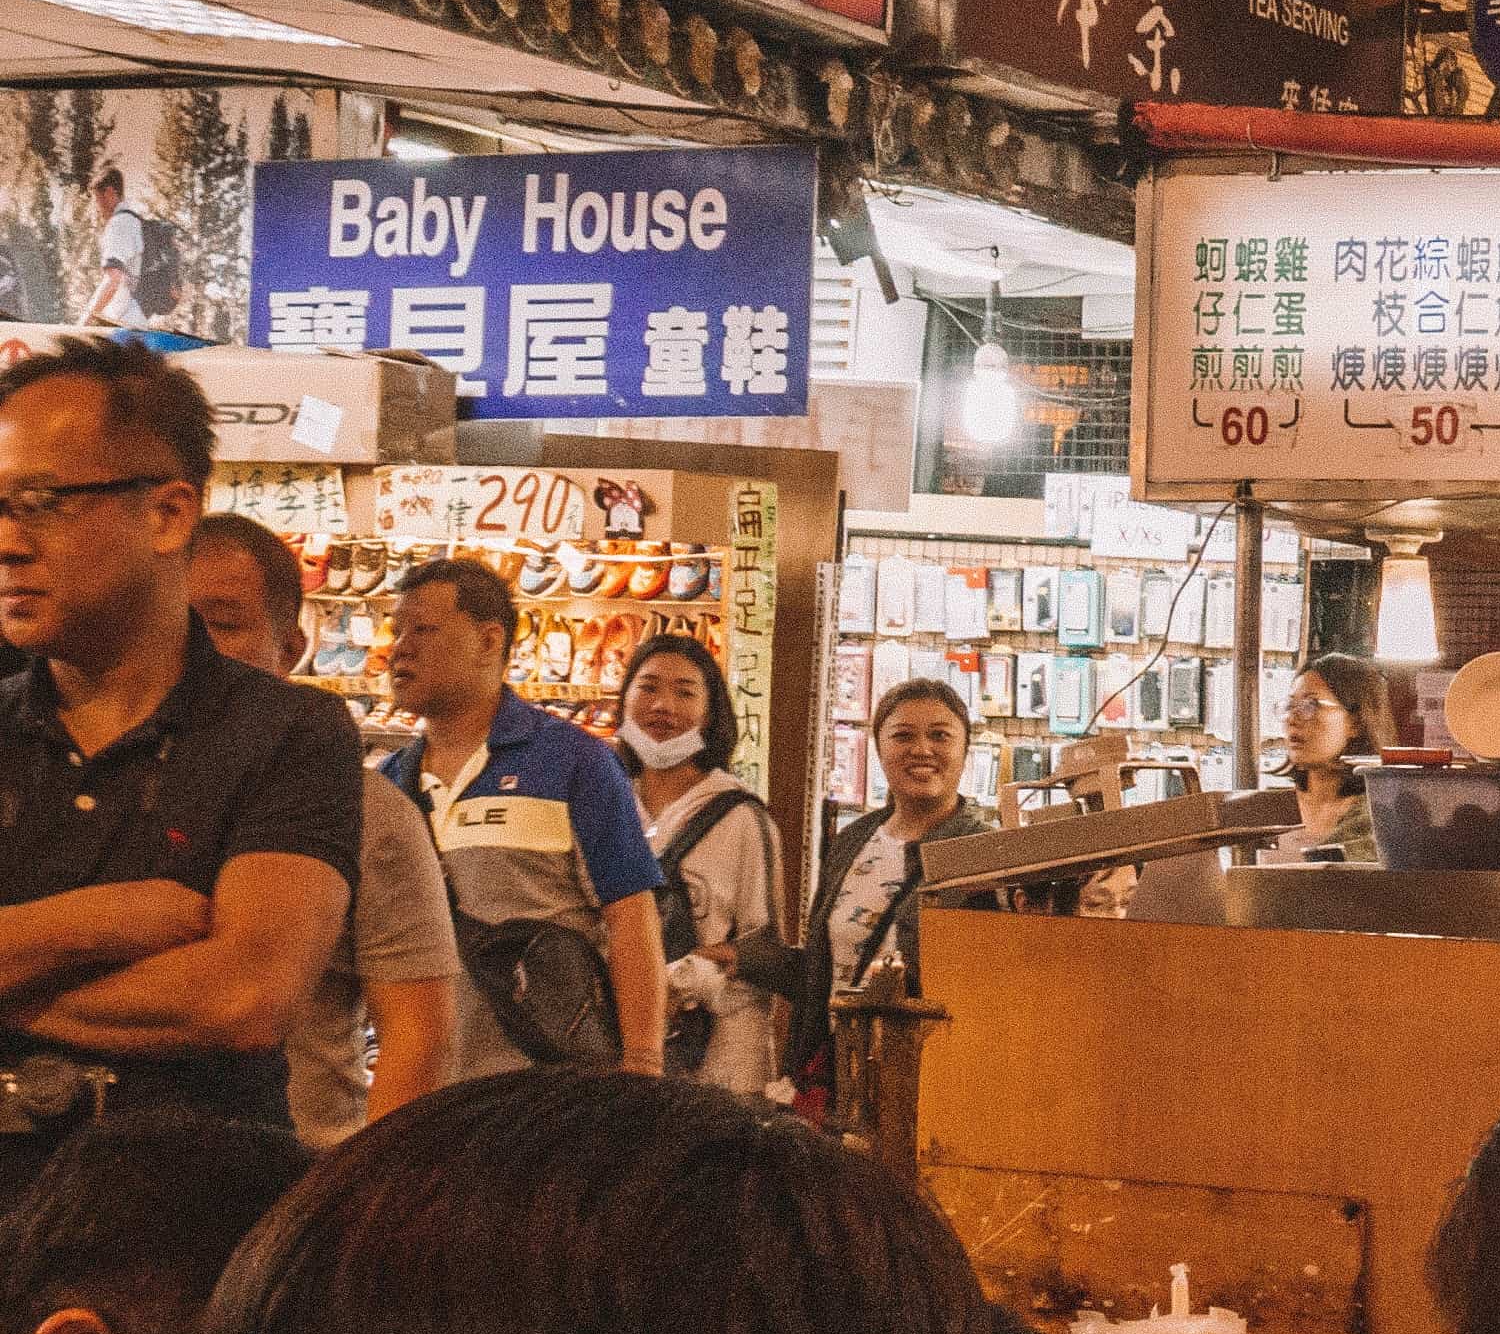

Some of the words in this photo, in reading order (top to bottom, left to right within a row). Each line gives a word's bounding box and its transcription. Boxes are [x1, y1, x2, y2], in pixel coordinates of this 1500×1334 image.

[329, 178, 487, 278] Baby
[521, 172, 729, 255] House
[641, 304, 790, 397] 童鞋
[1189, 236, 1229, 391] 蚵仔煎
[1229, 236, 1268, 391] 蝦仁煎
[1269, 236, 1309, 391] 雞蛋煎
[1221, 406, 1269, 446] 60
[1410, 405, 1460, 446] 50
[474, 472, 571, 534] 290
